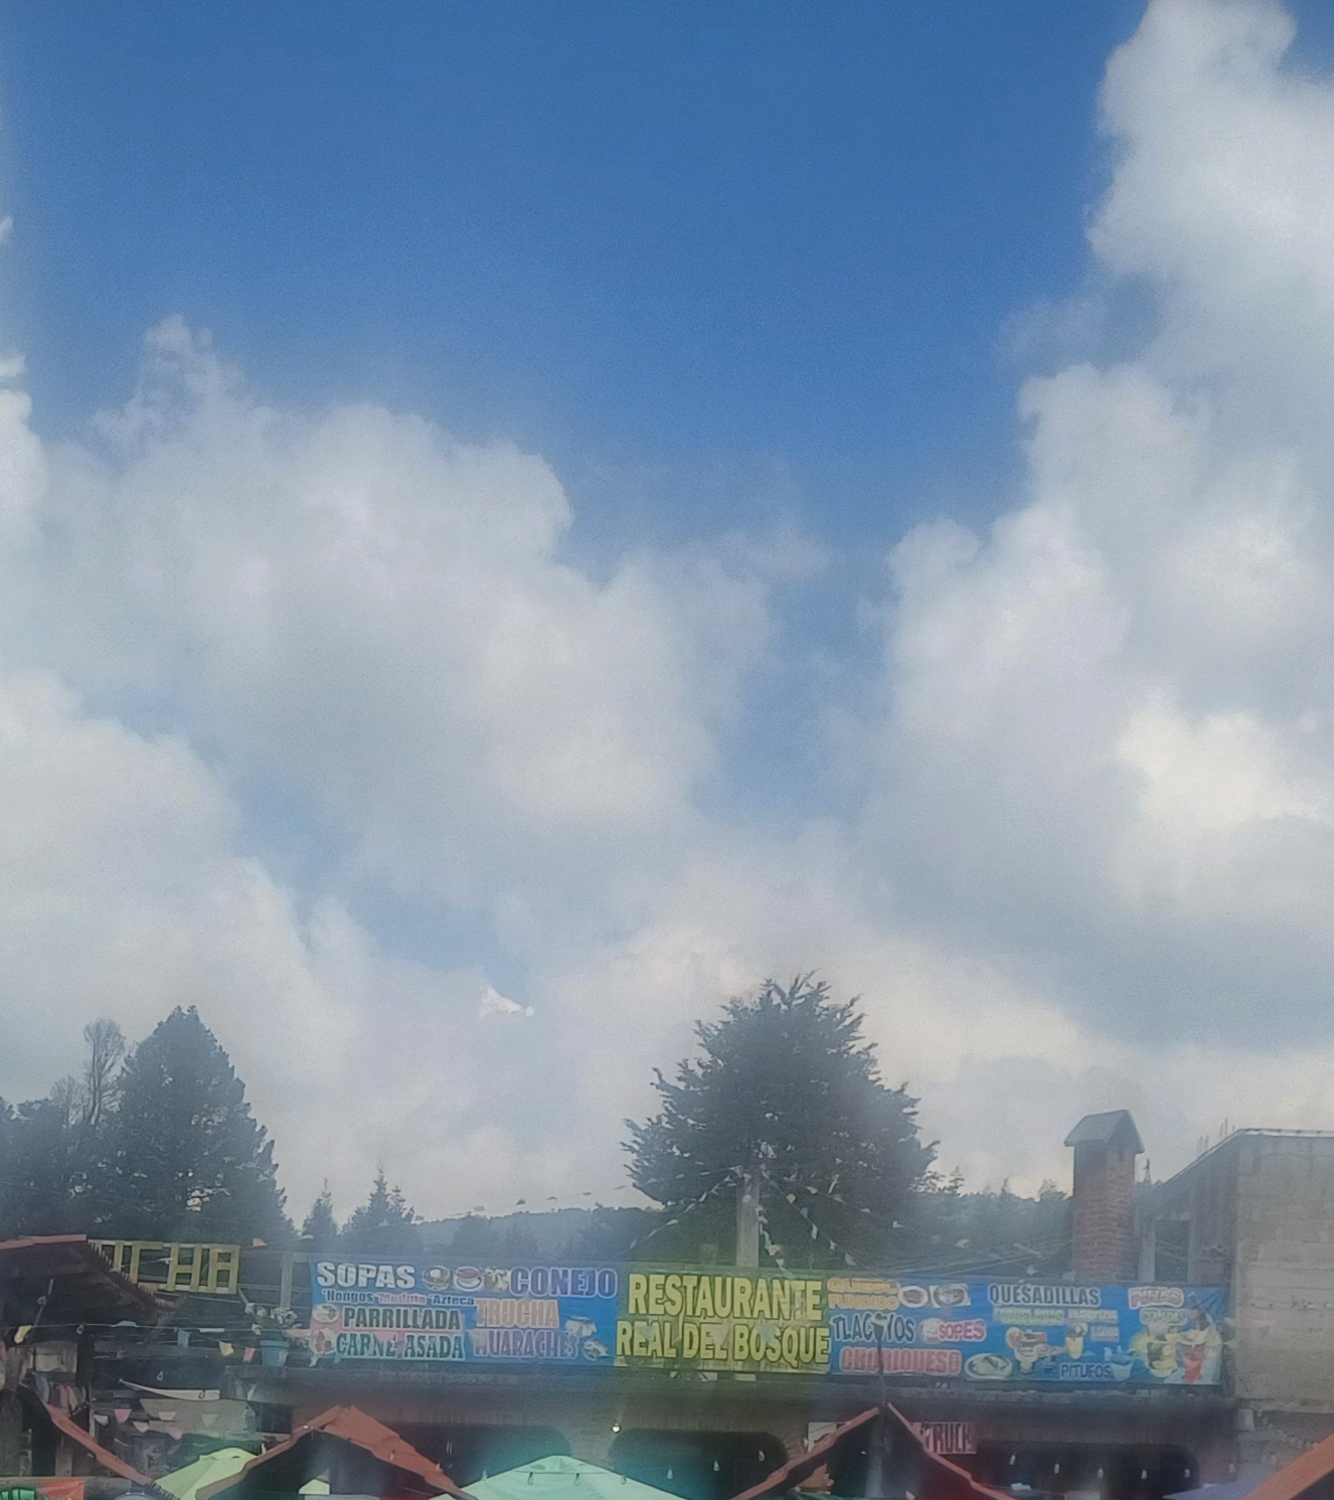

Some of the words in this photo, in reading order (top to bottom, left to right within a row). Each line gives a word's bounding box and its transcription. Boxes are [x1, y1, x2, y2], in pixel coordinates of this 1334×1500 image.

[317, 1262, 416, 1290] SOPAS
[511, 1267, 616, 1298] CONEJO
[628, 1273, 822, 1320] RESTAURANTE
[989, 1287, 1099, 1305] QUESADILLAS
[343, 1306, 461, 1330] PARRILLADA
[475, 1300, 558, 1327] TRUCHA
[939, 1321, 986, 1341] SOPES
[404, 1335, 463, 1358] ASADA
[617, 1320, 676, 1357] REAL
[683, 1322, 727, 1360] DEL
[734, 1324, 830, 1369] BOSQUE
[1060, 1363, 1111, 1379] PITUFOS
